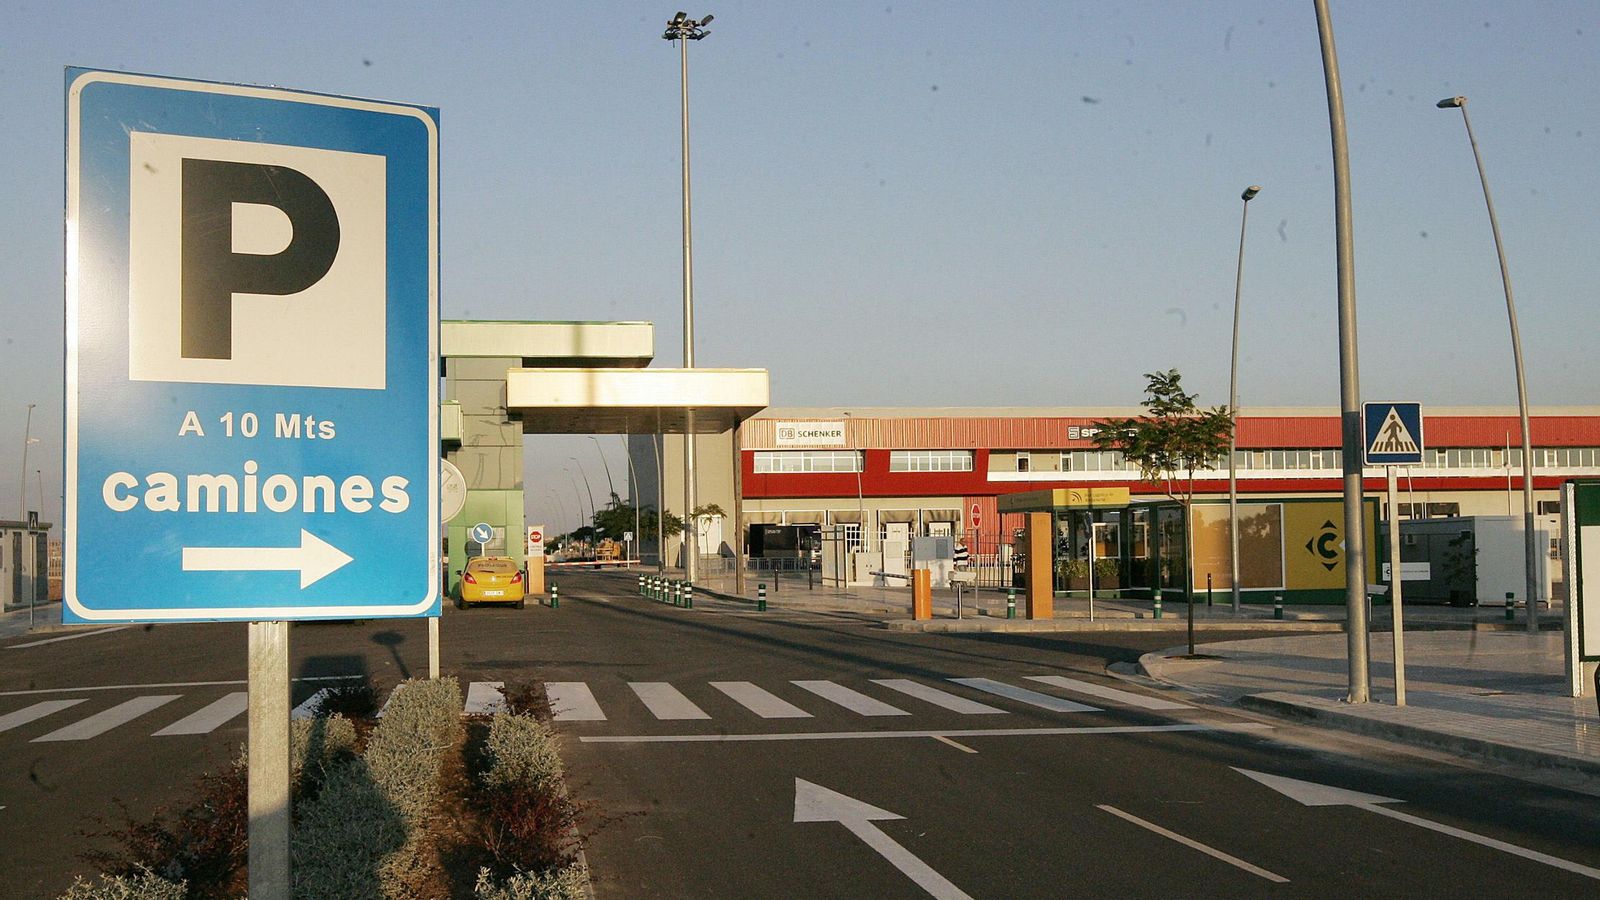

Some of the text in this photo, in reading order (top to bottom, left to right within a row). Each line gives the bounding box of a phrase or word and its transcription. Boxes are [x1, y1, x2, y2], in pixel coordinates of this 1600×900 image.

[181, 157, 341, 360] P
[178, 411, 336, 440] A 10 Mts
[781, 429, 842, 438] DB SCHENKER
[102, 459, 410, 513] camiones
